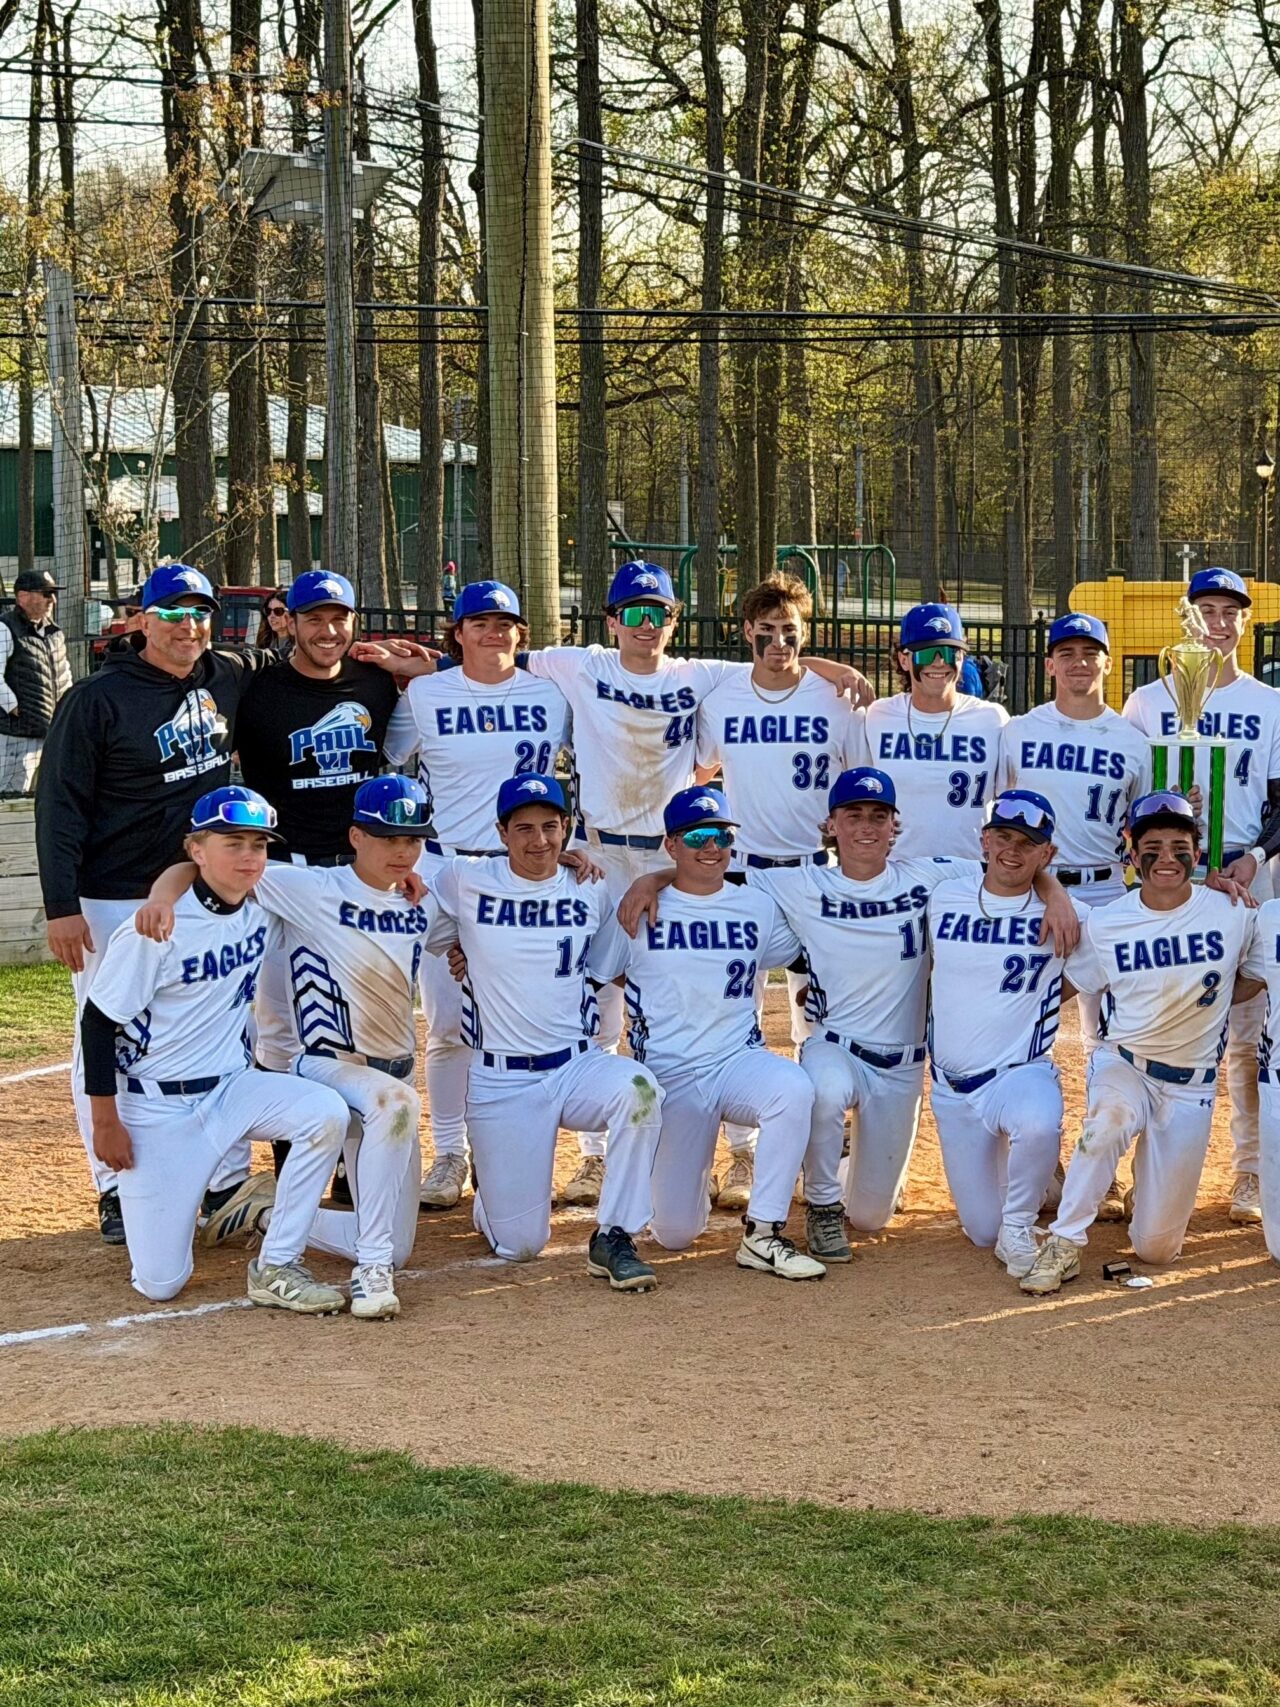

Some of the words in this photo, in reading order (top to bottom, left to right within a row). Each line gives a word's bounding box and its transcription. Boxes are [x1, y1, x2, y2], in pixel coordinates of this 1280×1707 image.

[597, 679, 696, 713] EAGLES
[435, 704, 548, 736] EAGLES
[724, 715, 829, 745] EAGLES
[1161, 711, 1261, 741] EGLES
[288, 724, 377, 765] PAUL
[312, 750, 354, 771] VI
[513, 739, 551, 778] 26
[879, 732, 987, 764] EAGLES
[1021, 741, 1125, 780] EAGLES
[292, 770, 374, 790] BASEBALL
[792, 752, 830, 790] 32
[1234, 748, 1253, 787] 4
[947, 770, 988, 808] 31
[1085, 784, 1122, 825] 11
[339, 900, 427, 934] EAGLES
[477, 894, 588, 929] EAGLES
[821, 885, 929, 919] EAGLES
[647, 920, 758, 951] EAGLES
[936, 912, 1042, 946] EAGLES
[180, 926, 267, 985] EAGLES
[1115, 930, 1225, 973] EAGLES
[999, 953, 1053, 993] 27
[1197, 970, 1222, 1008] 2
